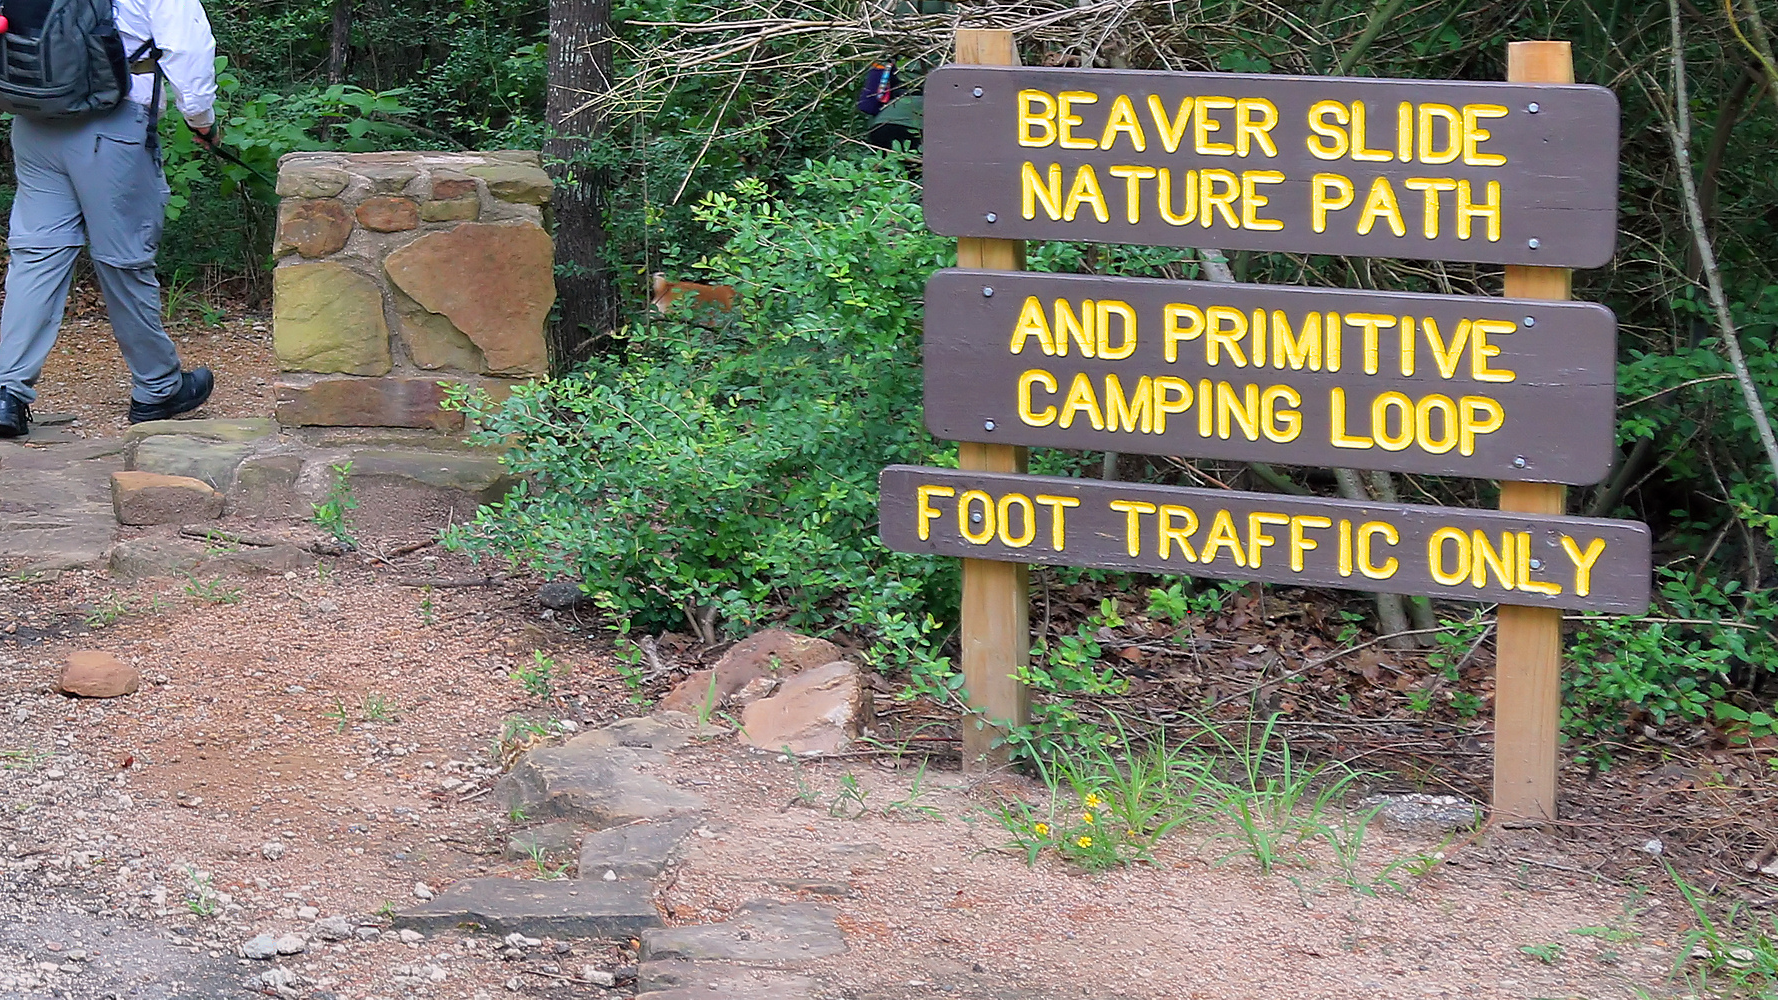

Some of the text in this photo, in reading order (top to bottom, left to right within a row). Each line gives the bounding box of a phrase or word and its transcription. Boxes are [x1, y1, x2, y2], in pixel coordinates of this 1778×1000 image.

[1017, 89, 1508, 165] BEAVER SLIDE
[1021, 161, 1500, 241] NATURE PATH
[1009, 296, 1517, 381] AND PRIMITIVE
[1017, 369, 1504, 455] CAMPING LOOP
[917, 485, 1605, 596] FOOT TRAFFIC ONLY
